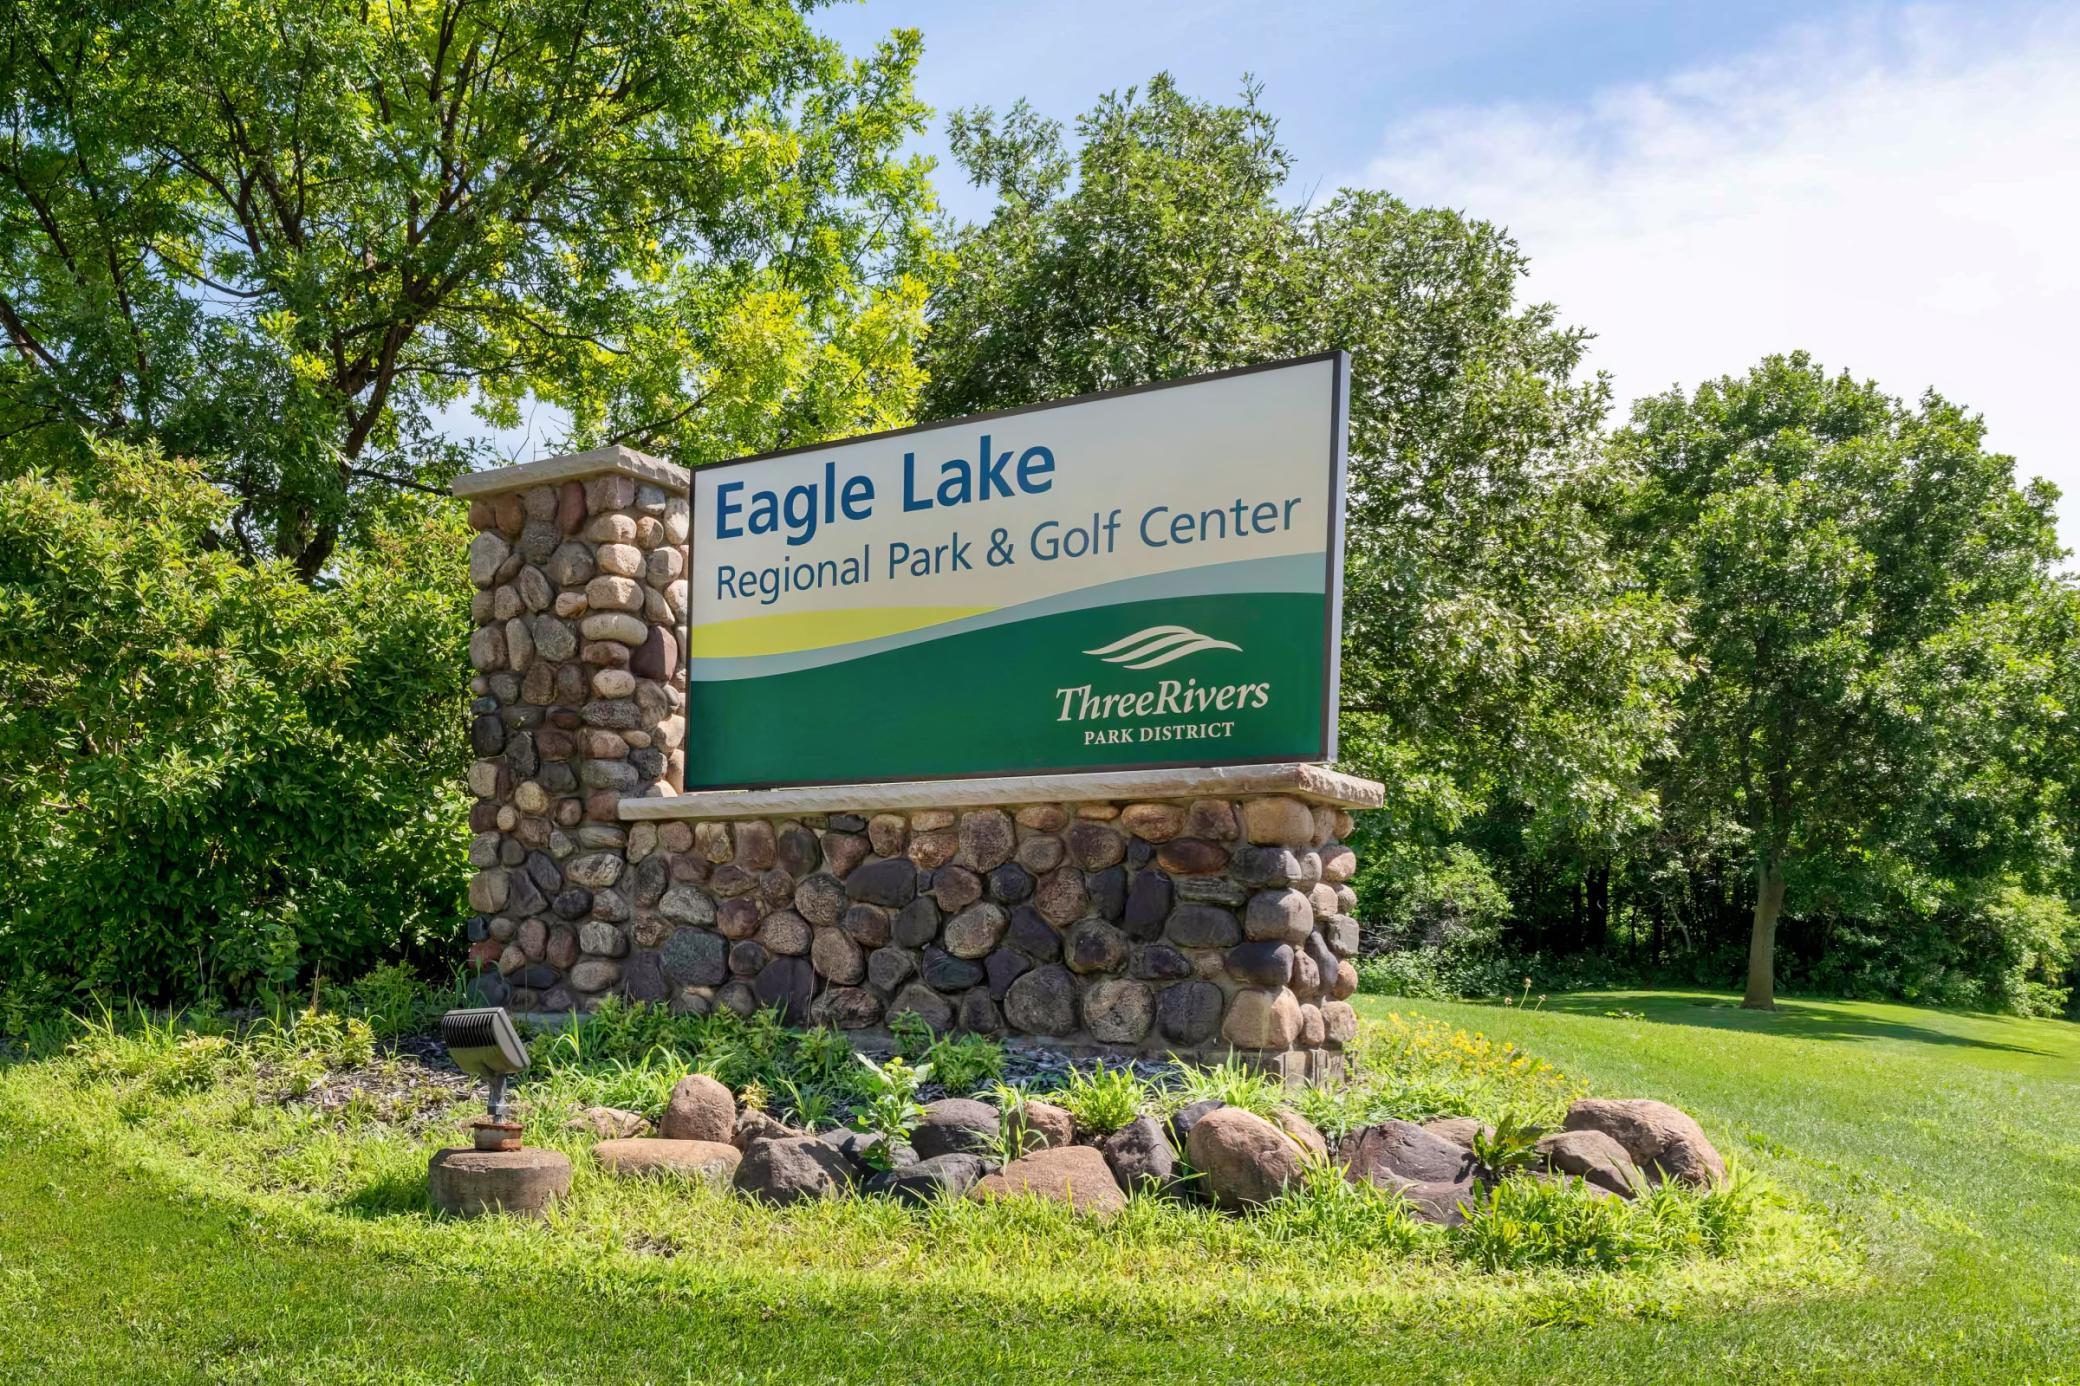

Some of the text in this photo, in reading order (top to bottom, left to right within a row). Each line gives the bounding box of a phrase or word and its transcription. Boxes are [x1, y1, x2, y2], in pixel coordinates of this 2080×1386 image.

[716, 434, 1056, 546] Eagle Lake
[716, 497, 1302, 606] Regional Park & Golf Center
[1055, 678, 1271, 722] ThreeRivers
[1084, 721, 1235, 745] PARK DISTRICT
